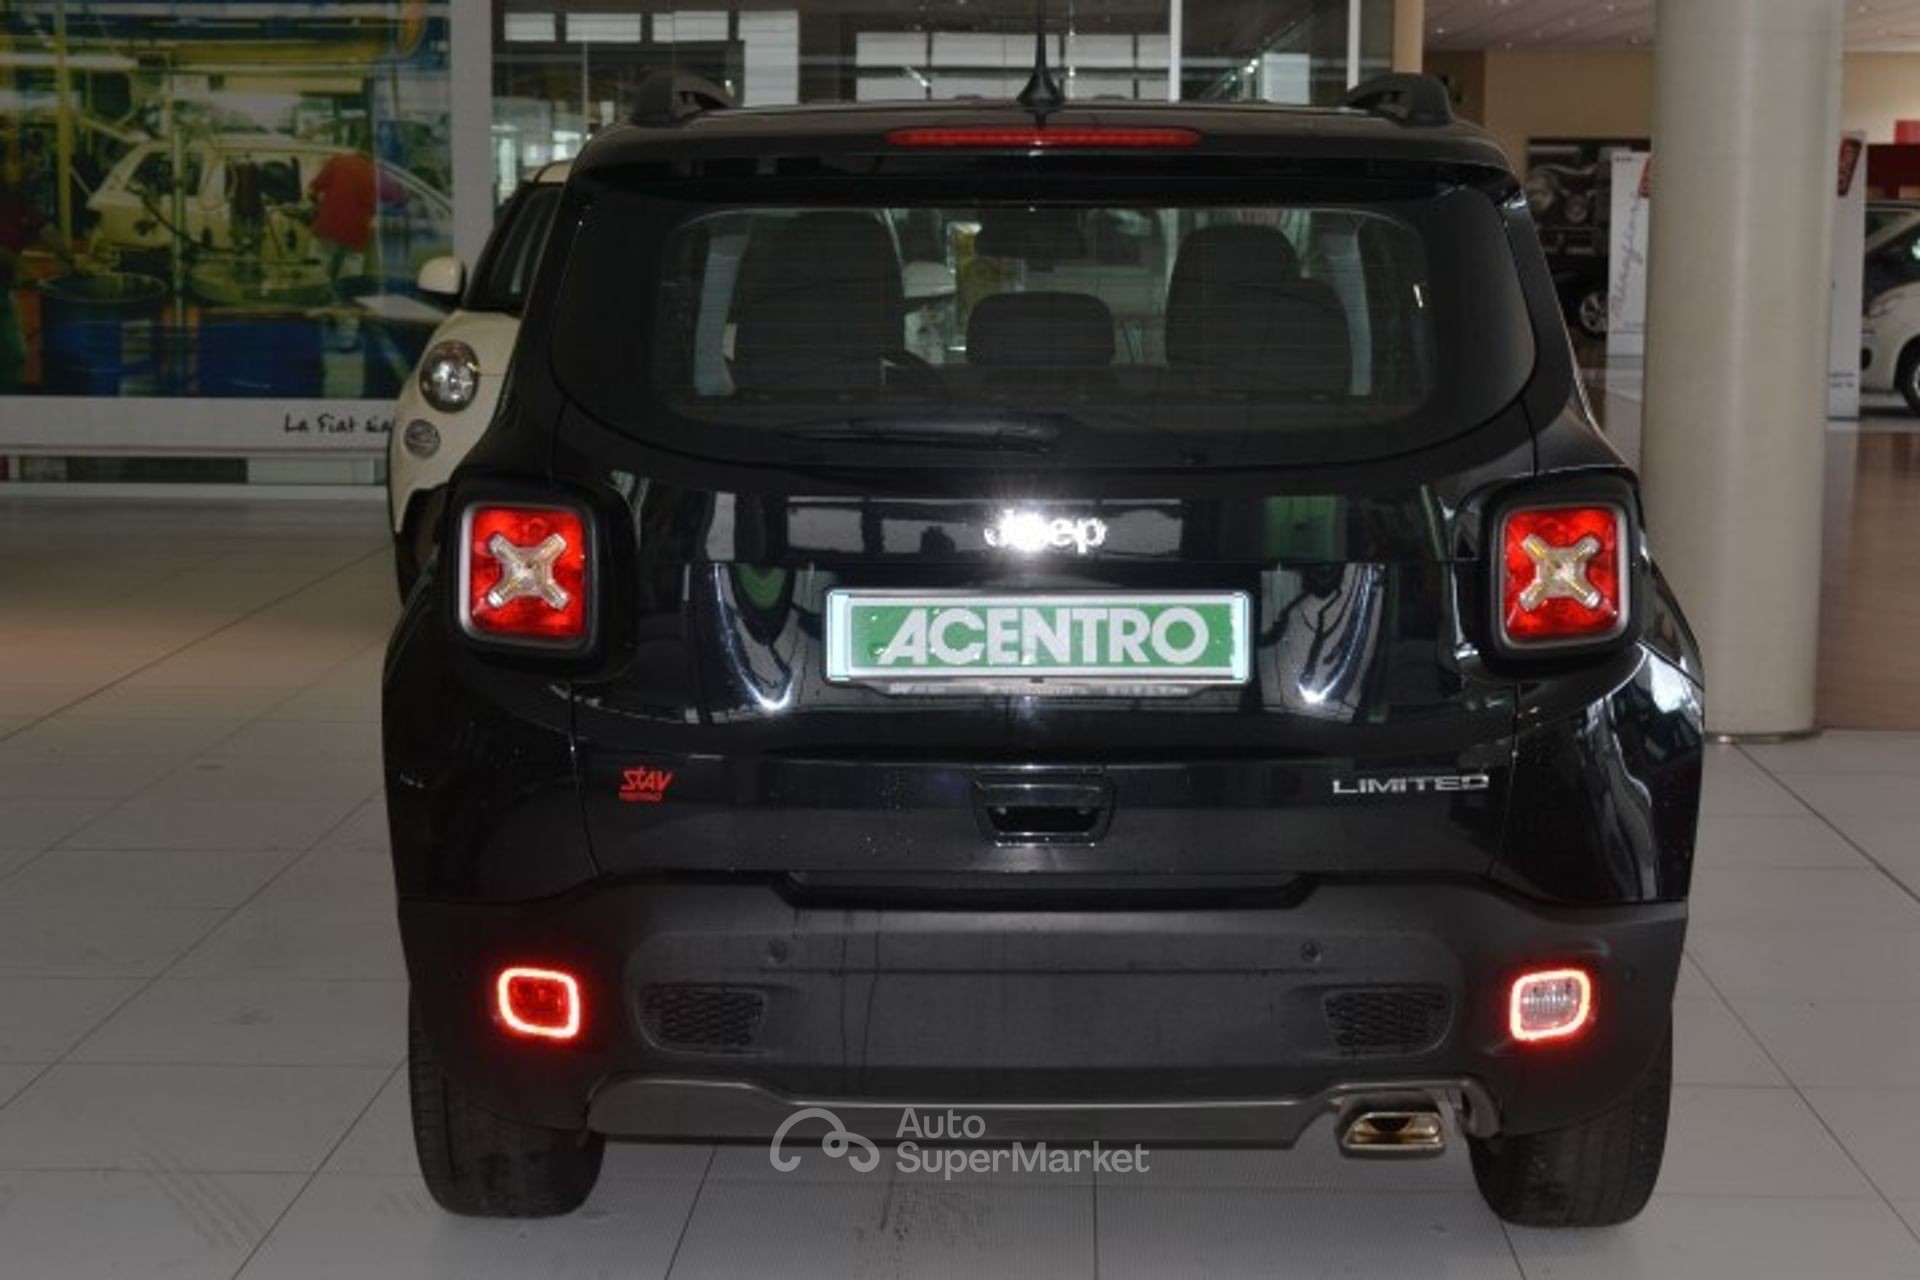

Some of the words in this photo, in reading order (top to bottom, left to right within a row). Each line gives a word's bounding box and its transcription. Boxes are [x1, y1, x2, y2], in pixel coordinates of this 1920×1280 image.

[285, 413, 309, 432] La
[317, 413, 354, 433] Fiat
[984, 509, 1107, 553] Jep
[877, 607, 1209, 665] ACENTRO
[1333, 775, 1490, 794] LIMITED
